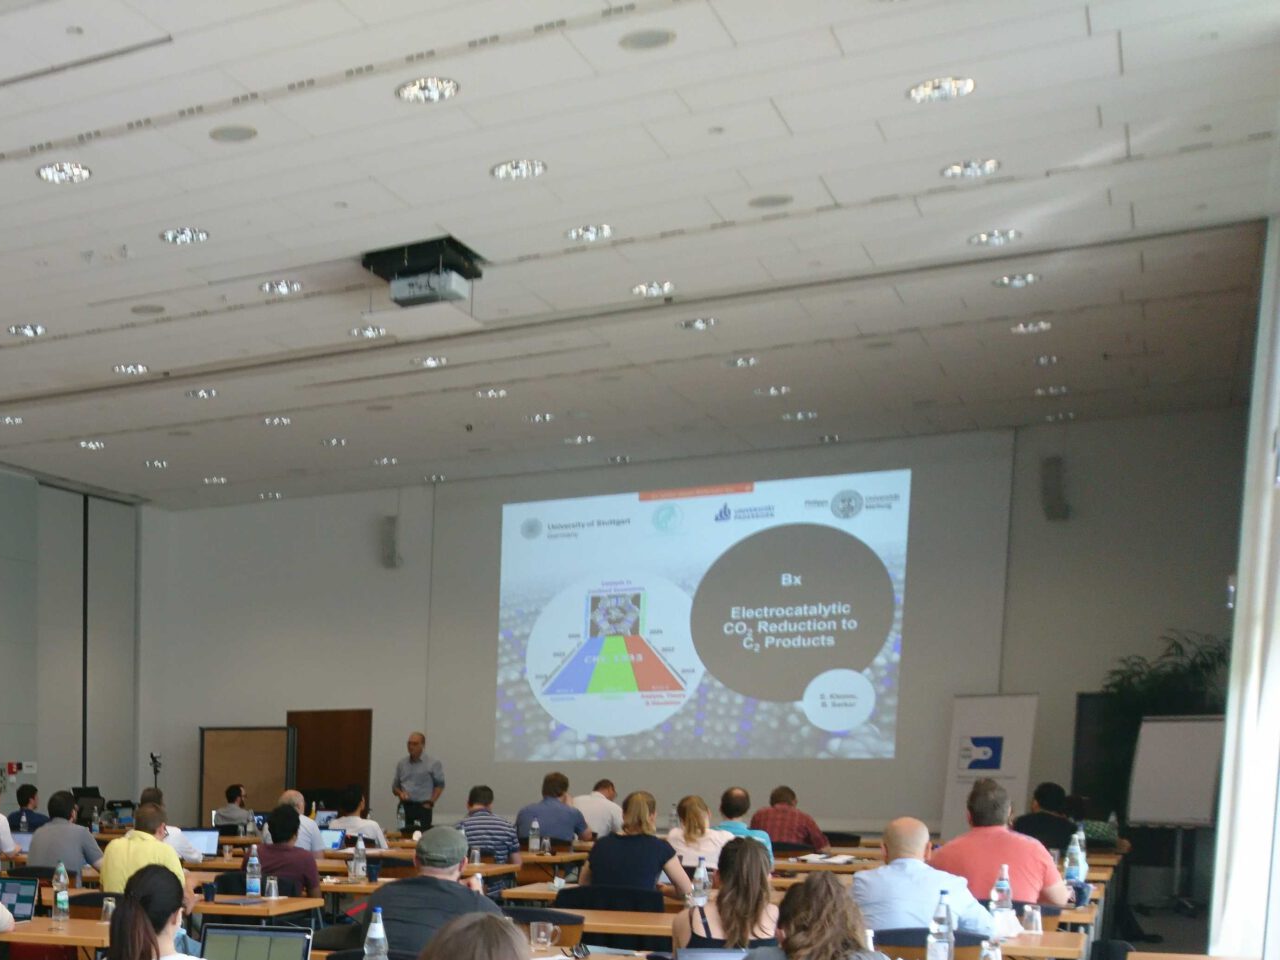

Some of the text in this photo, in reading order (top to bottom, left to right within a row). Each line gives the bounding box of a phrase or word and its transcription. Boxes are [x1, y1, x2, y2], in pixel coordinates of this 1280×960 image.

[781, 573, 802, 586] Bx
[731, 602, 851, 619] Electrocatalytic
[757, 619, 837, 634] Reduction
[841, 618, 858, 630] to
[764, 635, 836, 649] Products
